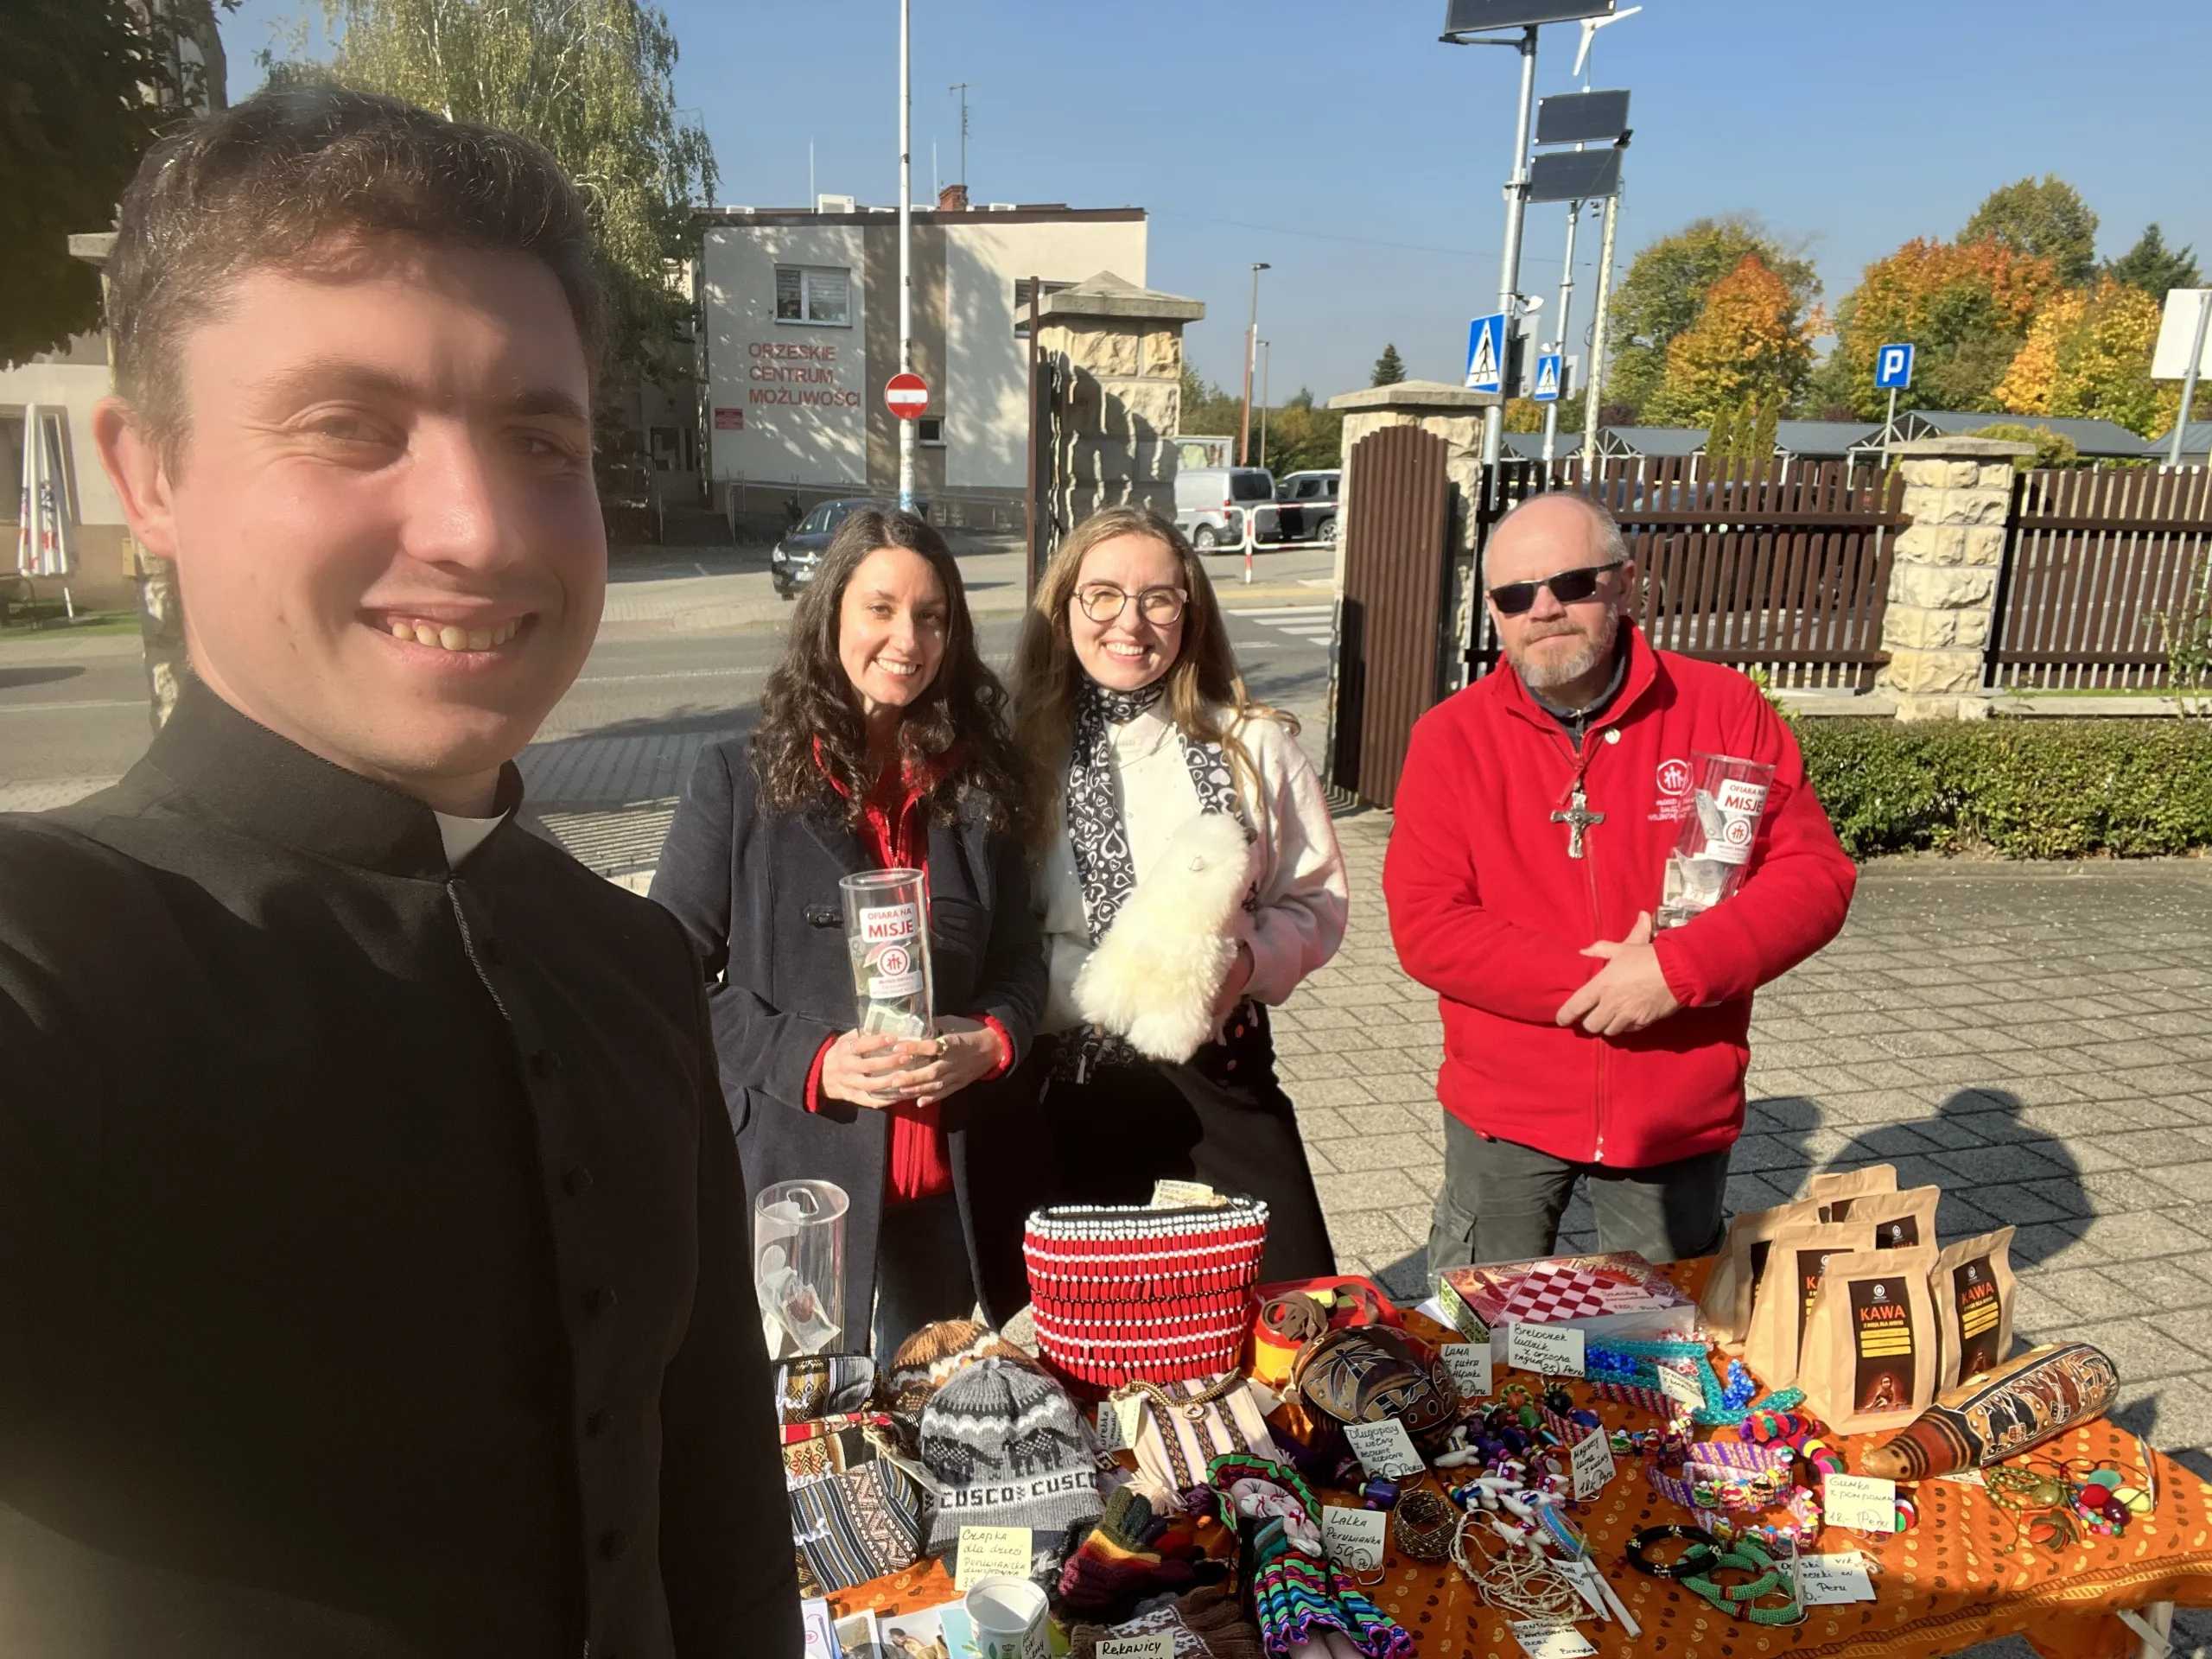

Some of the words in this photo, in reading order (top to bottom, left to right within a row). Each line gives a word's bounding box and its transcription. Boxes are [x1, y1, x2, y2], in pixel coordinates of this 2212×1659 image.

[748, 342, 836, 361] ORZESKIE
[749, 365, 834, 384] CENTRUM
[1882, 349, 1904, 383] P
[749, 387, 861, 408] MOŻLIWOŚCI
[1729, 785, 1757, 795] OFIARA
[1724, 795, 1763, 812] MISJE
[868, 910, 899, 920] OFIARA
[900, 907, 912, 917] NA
[868, 918, 914, 938] MISJE
[1961, 1281, 1995, 1306] KAWA
[1859, 1304, 1906, 1321] KAWA
[940, 1486, 1014, 1509] CUSCO
[1817, 1582, 1847, 1592] Peru
